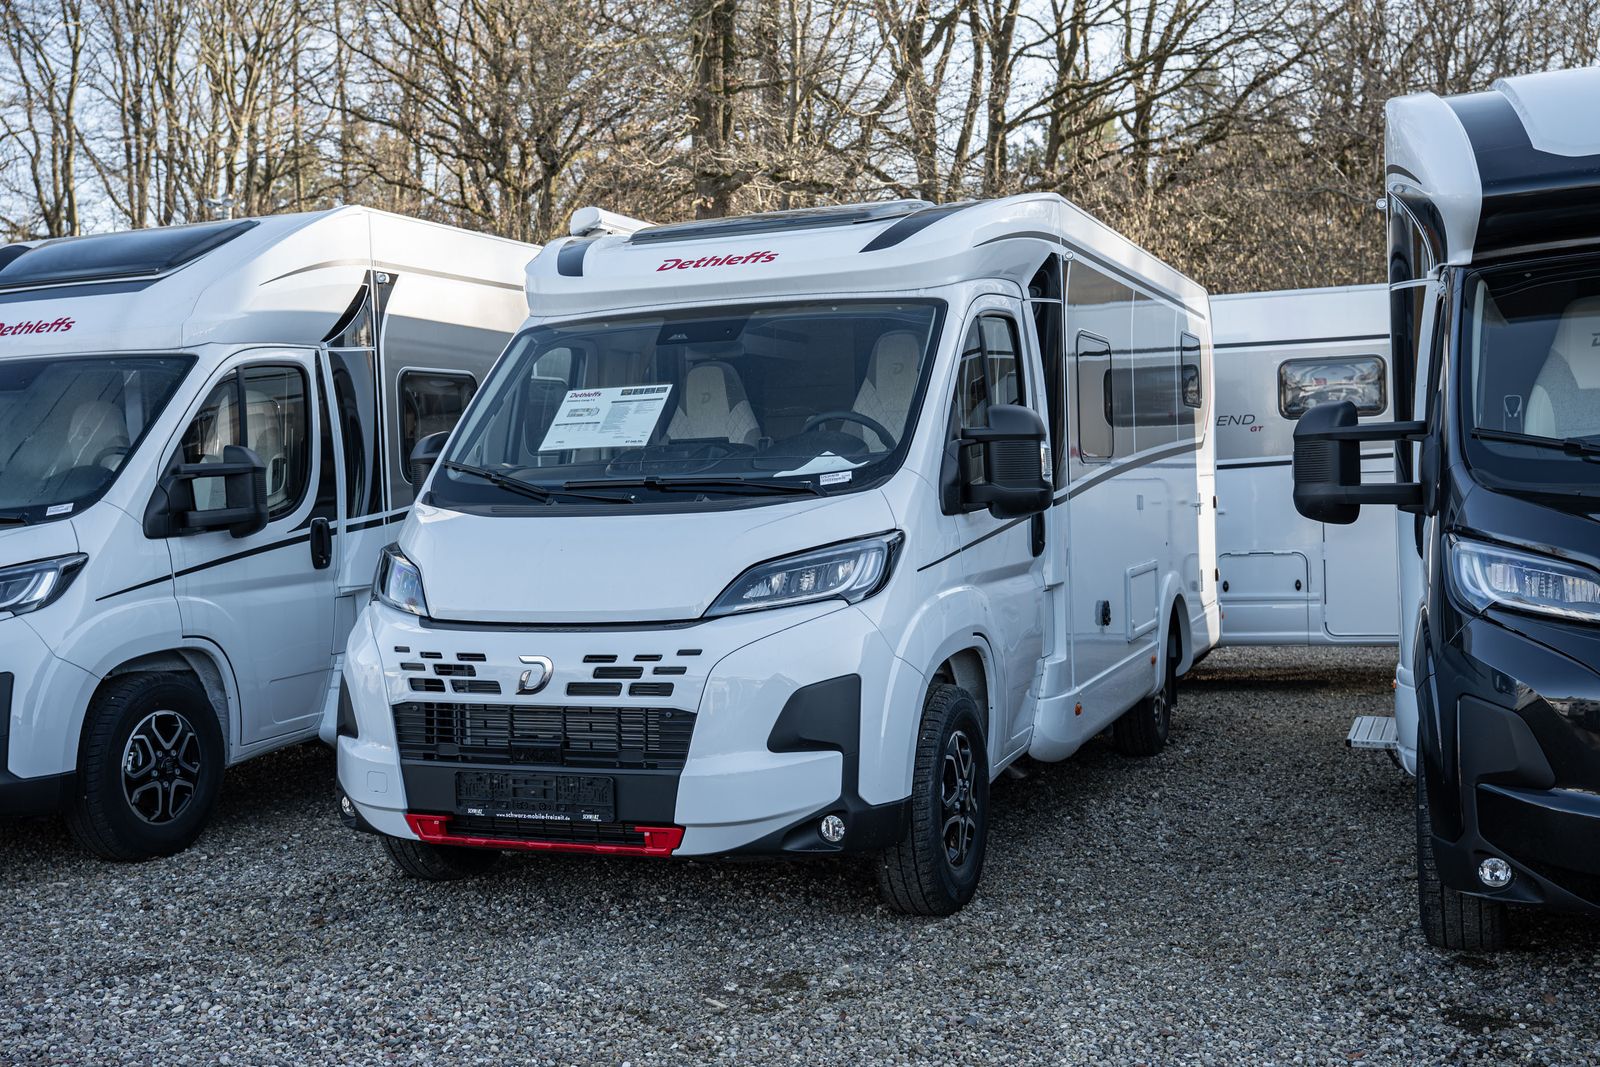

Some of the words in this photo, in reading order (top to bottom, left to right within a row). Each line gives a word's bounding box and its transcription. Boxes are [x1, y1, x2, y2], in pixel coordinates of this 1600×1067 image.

[656, 250, 779, 272] Dethleffs
[0, 316, 76, 336] ethleffs
[1215, 414, 1256, 426] END
